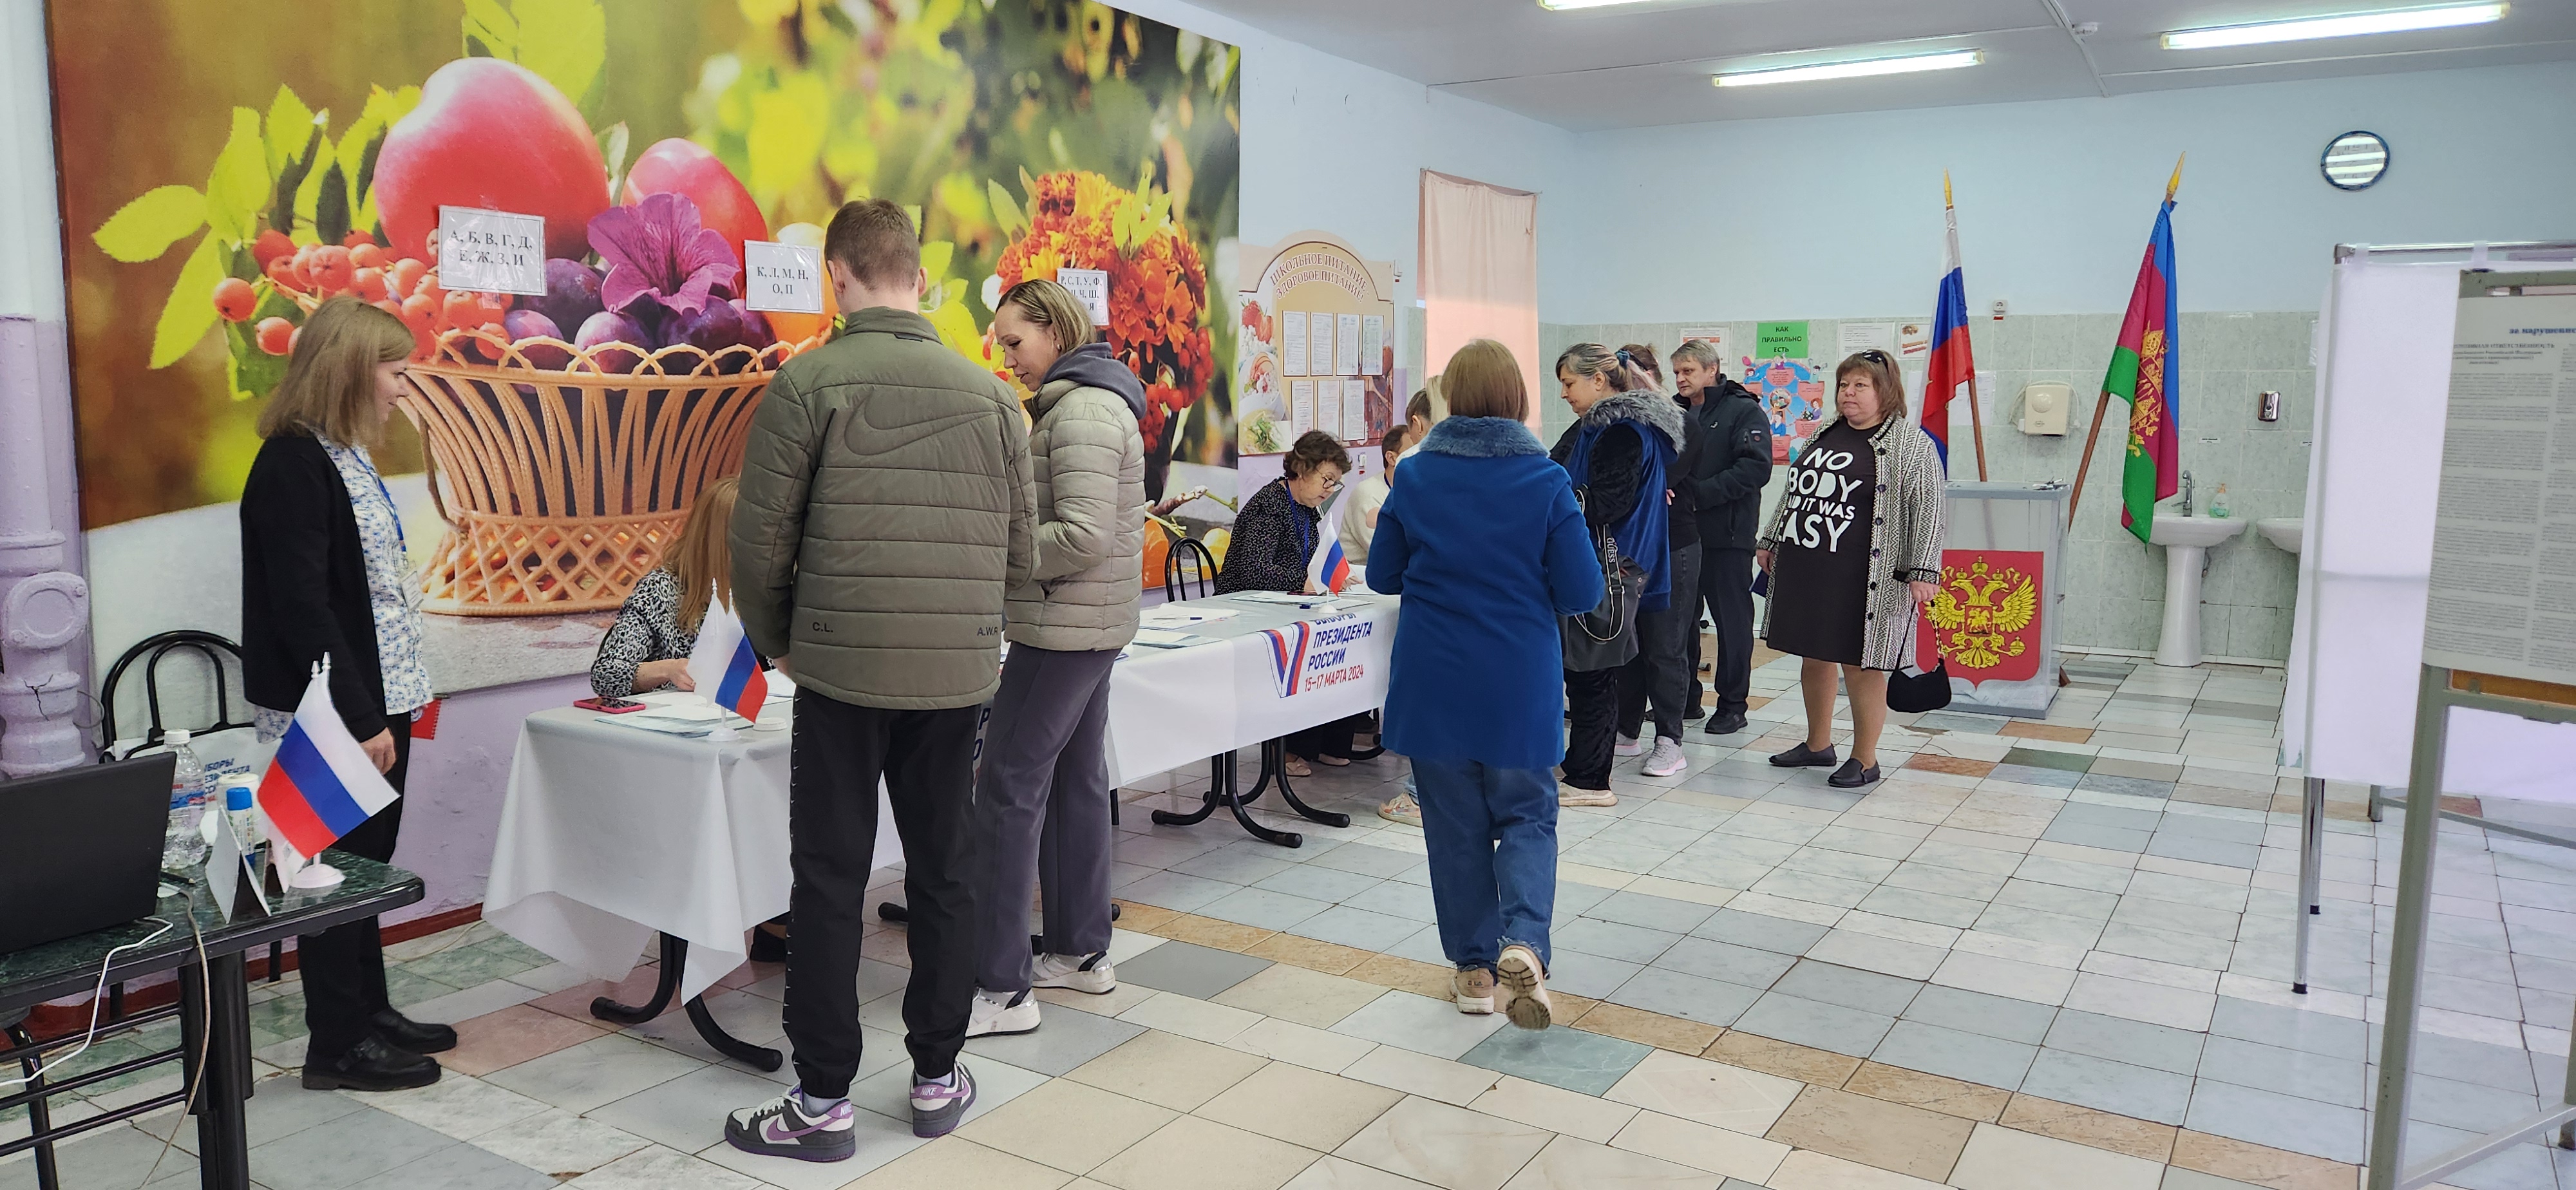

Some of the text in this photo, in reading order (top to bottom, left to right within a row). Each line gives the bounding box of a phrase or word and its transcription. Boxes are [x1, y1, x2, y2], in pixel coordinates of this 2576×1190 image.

[469, 231, 480, 244] Б,
[486, 233, 498, 247] В,
[502, 234, 515, 249] Г,
[518, 236, 532, 250] Д,
[460, 249, 471, 263] Е,
[498, 252, 509, 266] З,
[514, 254, 524, 266] И
[757, 267, 808, 281] К, Л, М, Н,
[1270, 254, 1323, 286] ШКОЛЬНОЕ
[1324, 255, 1367, 291] ПИТАНИЕ
[773, 283, 793, 295] О, П
[1276, 270, 1365, 302] ЗДОРОВОЕ ПИТАНИЕ!
[1803, 448, 1853, 471] NO
[1788, 467, 1863, 502] BODY
[1801, 497, 1816, 511] IT
[1819, 500, 1855, 520] WAS
[1606, 537, 1616, 563] GUESS
[813, 621, 833, 632] C.L.
[1313, 621, 1372, 648] ПРЕЗИДЕНТА
[1307, 647, 1347, 672] РОССИИ
[1324, 668, 1347, 687] МАРТА
[1348, 665, 1363, 681] 2024
[920, 1087, 937, 1095] NIKE
